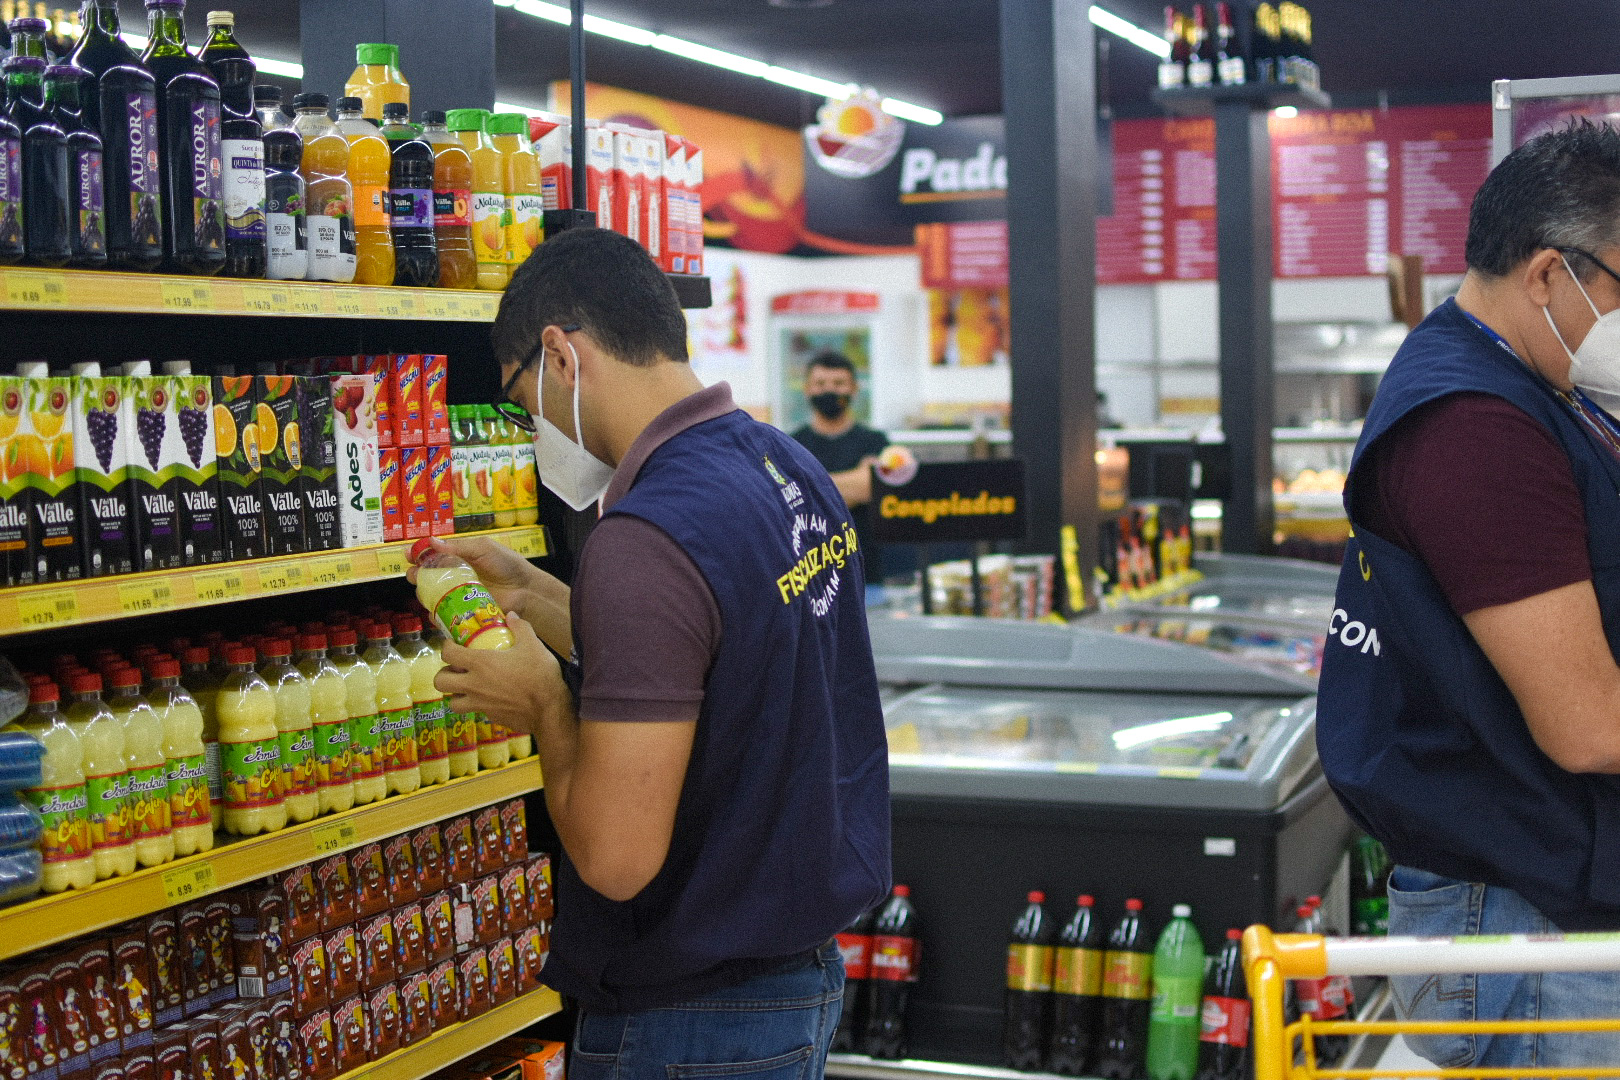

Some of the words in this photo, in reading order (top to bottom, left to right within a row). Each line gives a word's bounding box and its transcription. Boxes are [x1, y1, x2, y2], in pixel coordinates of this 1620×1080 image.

[128, 96, 145, 191] AURORA
[193, 105, 208, 197] AURORA
[81, 152, 91, 210] AURORA
[380, 461, 398, 482] ESCAU
[405, 459, 426, 482] NESCAU
[430, 458, 451, 480] NESCAU
[91, 497, 126, 518] Valle
[142, 494, 175, 514] Valle
[183, 490, 217, 511] Valle
[226, 495, 261, 515] Valle
[268, 492, 301, 512] Valle
[306, 489, 337, 509] Valle
[0, 505, 27, 527] alle
[36, 502, 74, 524] Valle
[278, 514, 299, 526] 100%
[315, 511, 335, 522] 100%
[238, 519, 259, 530] 100%
[286, 543, 292, 552] 1L
[323, 539, 329, 548] 1L
[200, 554, 207, 562] 1L
[269, 579, 286, 589] 12,79
[319, 573, 336, 583] 12,79
[206, 589, 224, 599] 11,69
[32, 612, 54, 624] 12,79
[386, 735, 410, 756] Caju
[418, 725, 440, 746] Caju
[133, 797, 161, 821] Caju
[57, 818, 86, 843] Caju
[324, 839, 338, 850] 2,19
